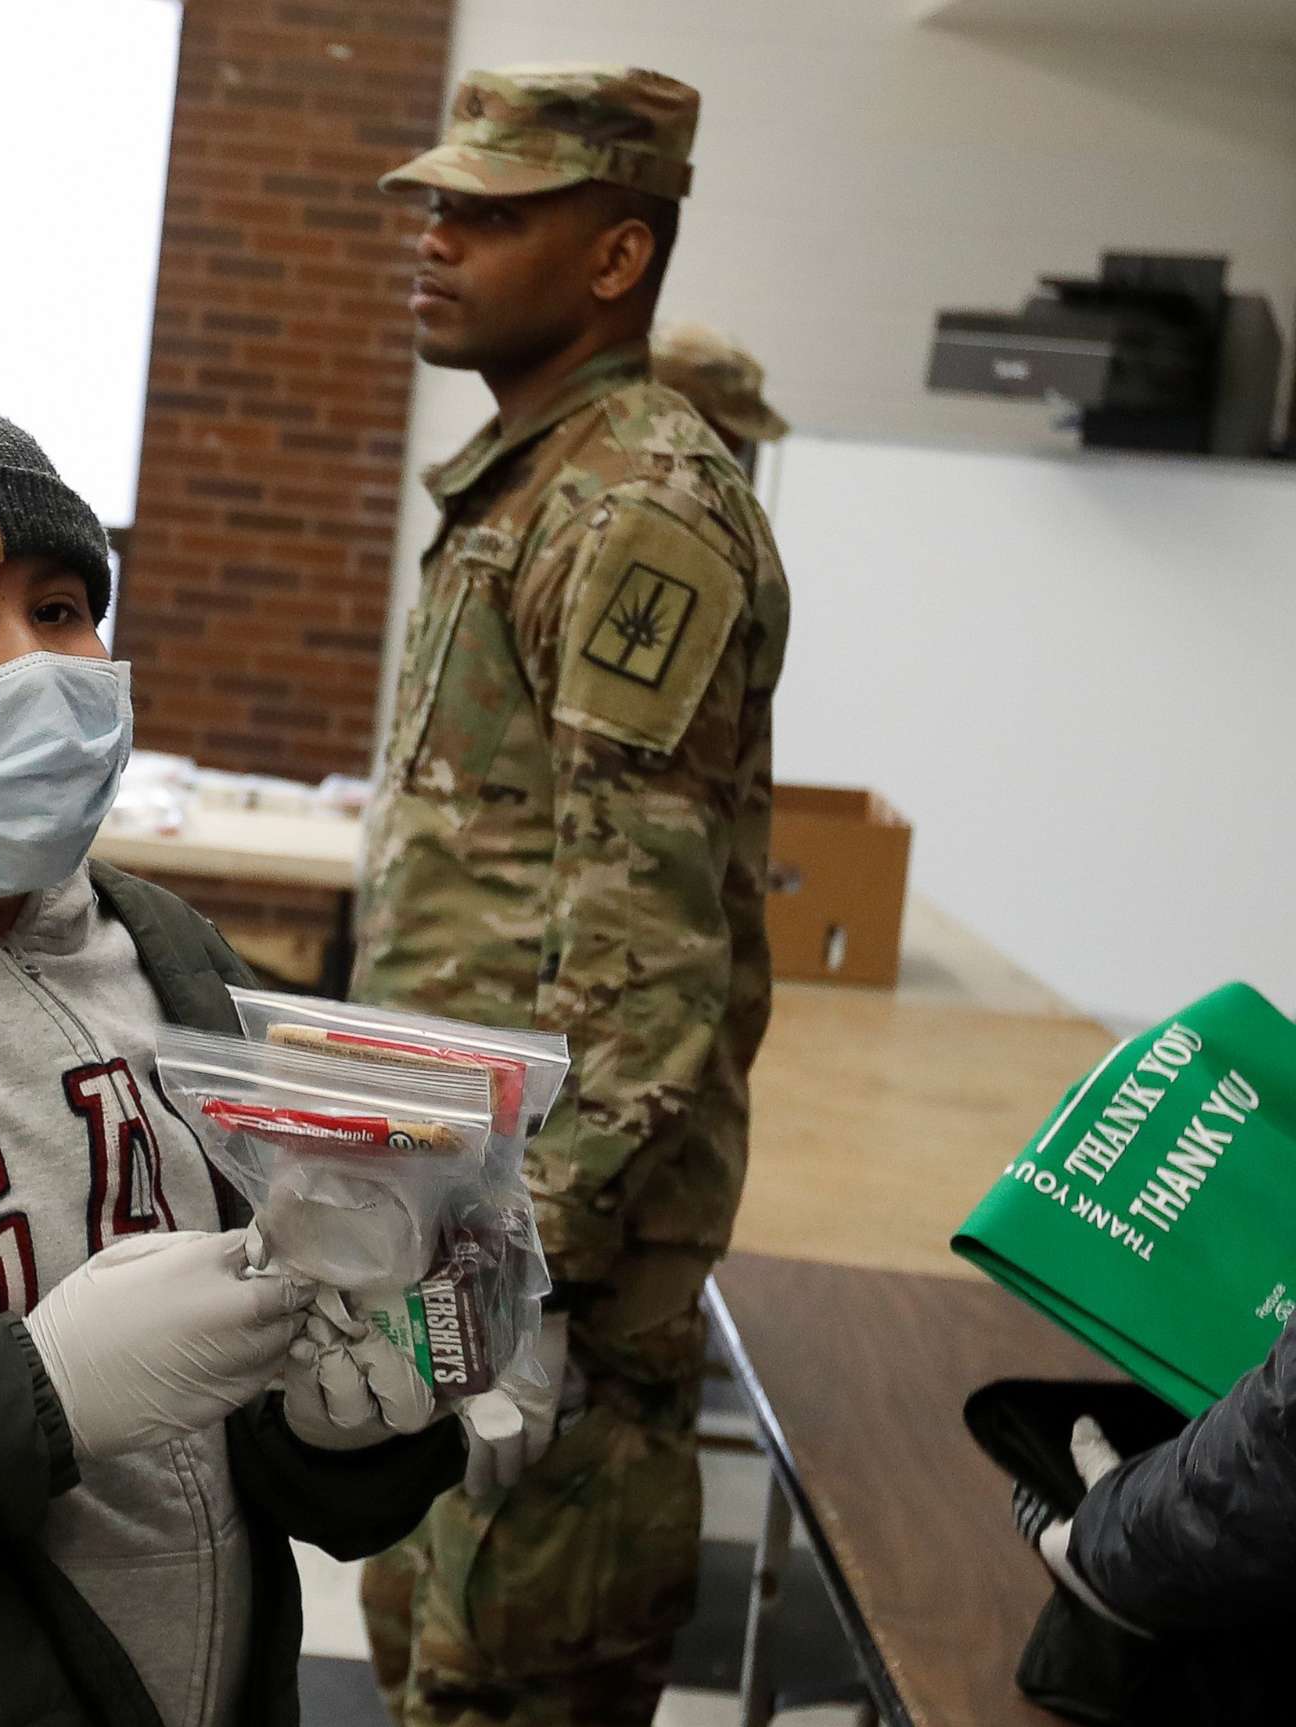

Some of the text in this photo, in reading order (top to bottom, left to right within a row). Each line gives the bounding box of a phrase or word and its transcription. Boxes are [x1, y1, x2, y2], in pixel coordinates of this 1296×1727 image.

[1064, 1022, 1203, 1186] THANK YOU
[1015, 1161, 1154, 1261] THANK YOU
[1128, 1114, 1233, 1232] THANK
[420, 1280, 467, 1383] HERSHEY'S
